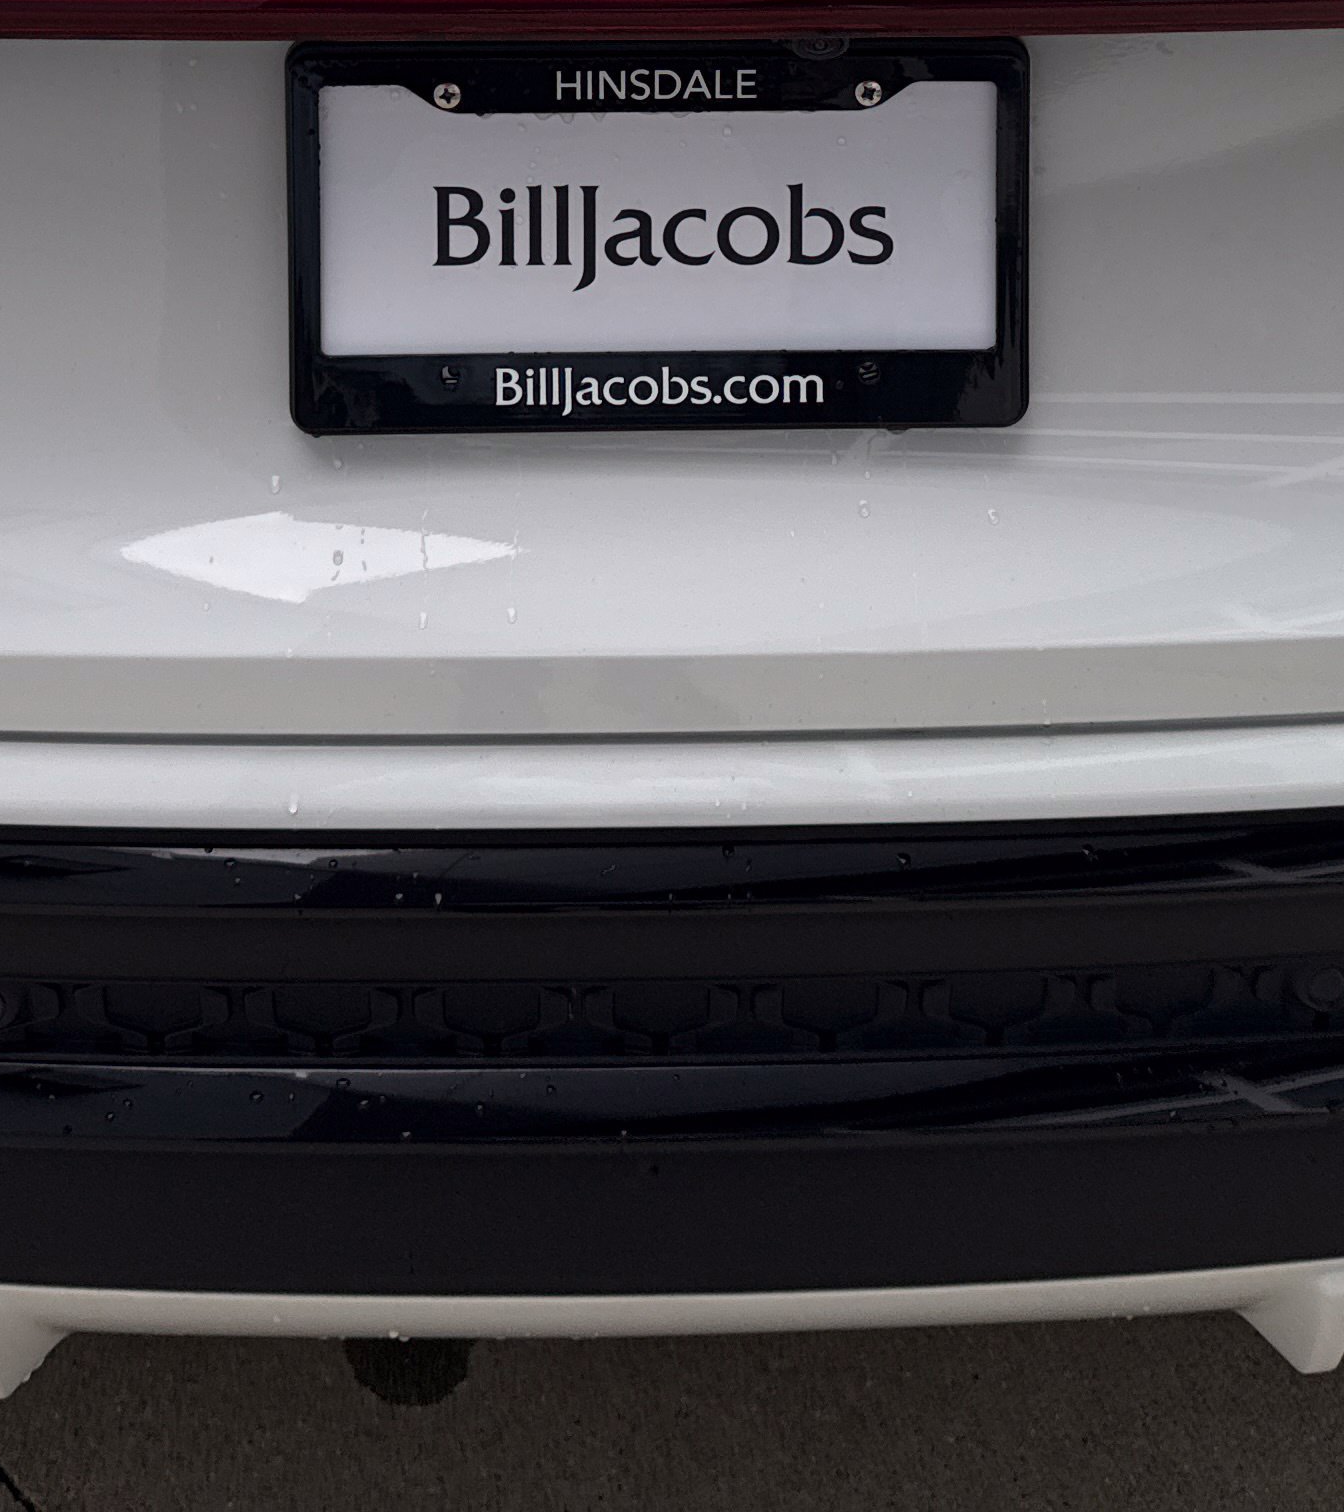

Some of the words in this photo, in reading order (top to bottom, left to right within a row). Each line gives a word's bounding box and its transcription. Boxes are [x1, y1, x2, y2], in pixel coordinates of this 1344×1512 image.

[556, 70, 757, 100] HINSDALE
[432, 183, 894, 292] BillJacobs
[495, 366, 824, 416] BillJacobs.com
